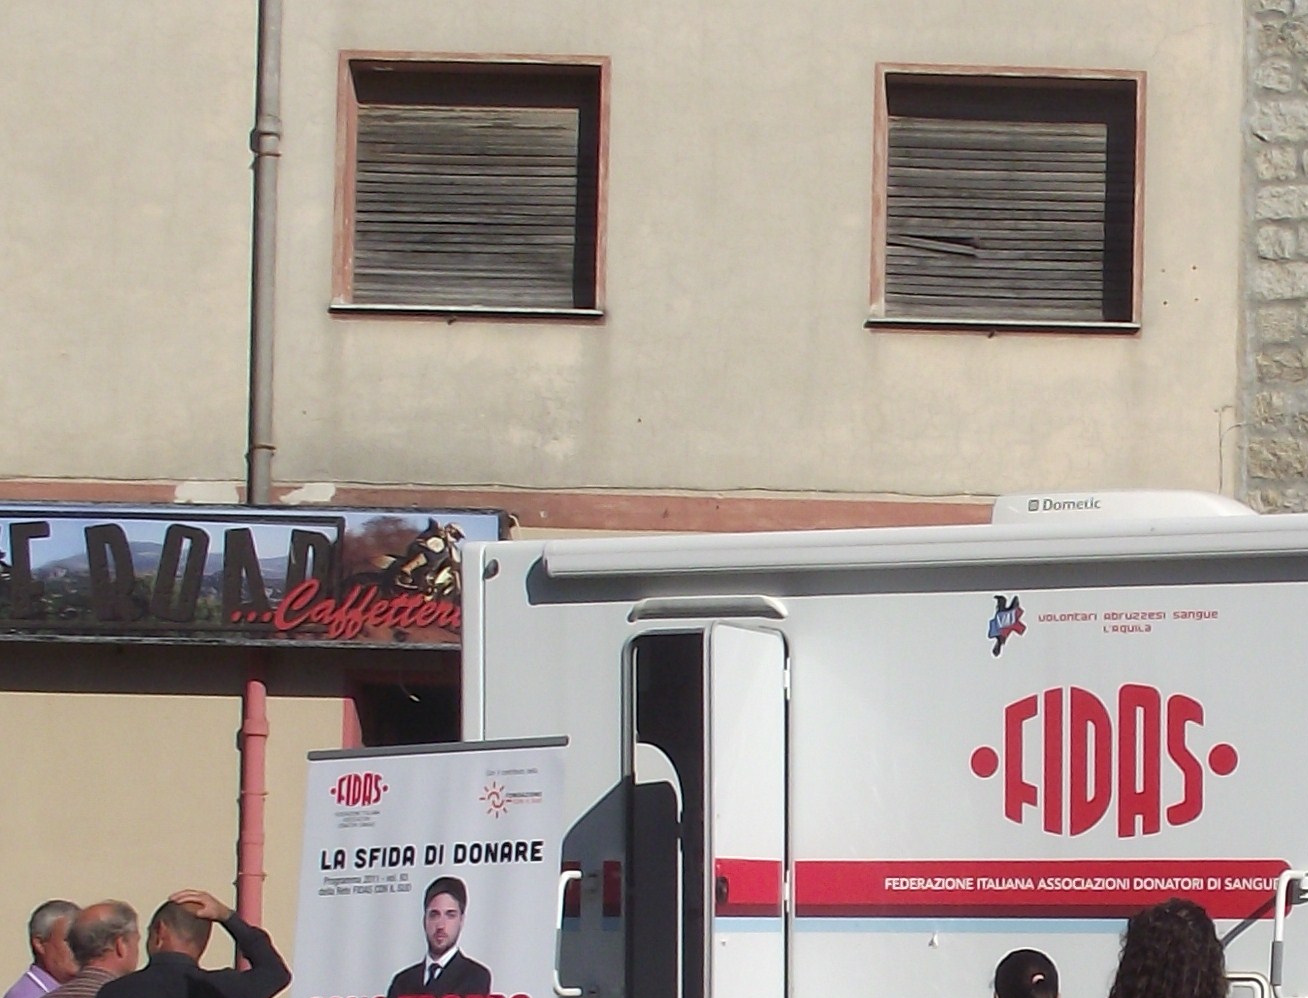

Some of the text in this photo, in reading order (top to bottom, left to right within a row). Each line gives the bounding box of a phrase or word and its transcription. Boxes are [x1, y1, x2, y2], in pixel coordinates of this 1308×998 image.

[1042, 497, 1101, 511] Dometic
[1005, 683, 1204, 838] FIDAS
[336, 773, 382, 807] FIDAS
[320, 841, 544, 870] LA SFIDA DI DONARE
[885, 877, 974, 890] FEDERAZIONE
[976, 877, 1034, 890] ITALIANA
[1037, 877, 1130, 890] ASSOCIAZIONI
[1133, 877, 1204, 890] DONATORI
[1208, 877, 1221, 890] DI
